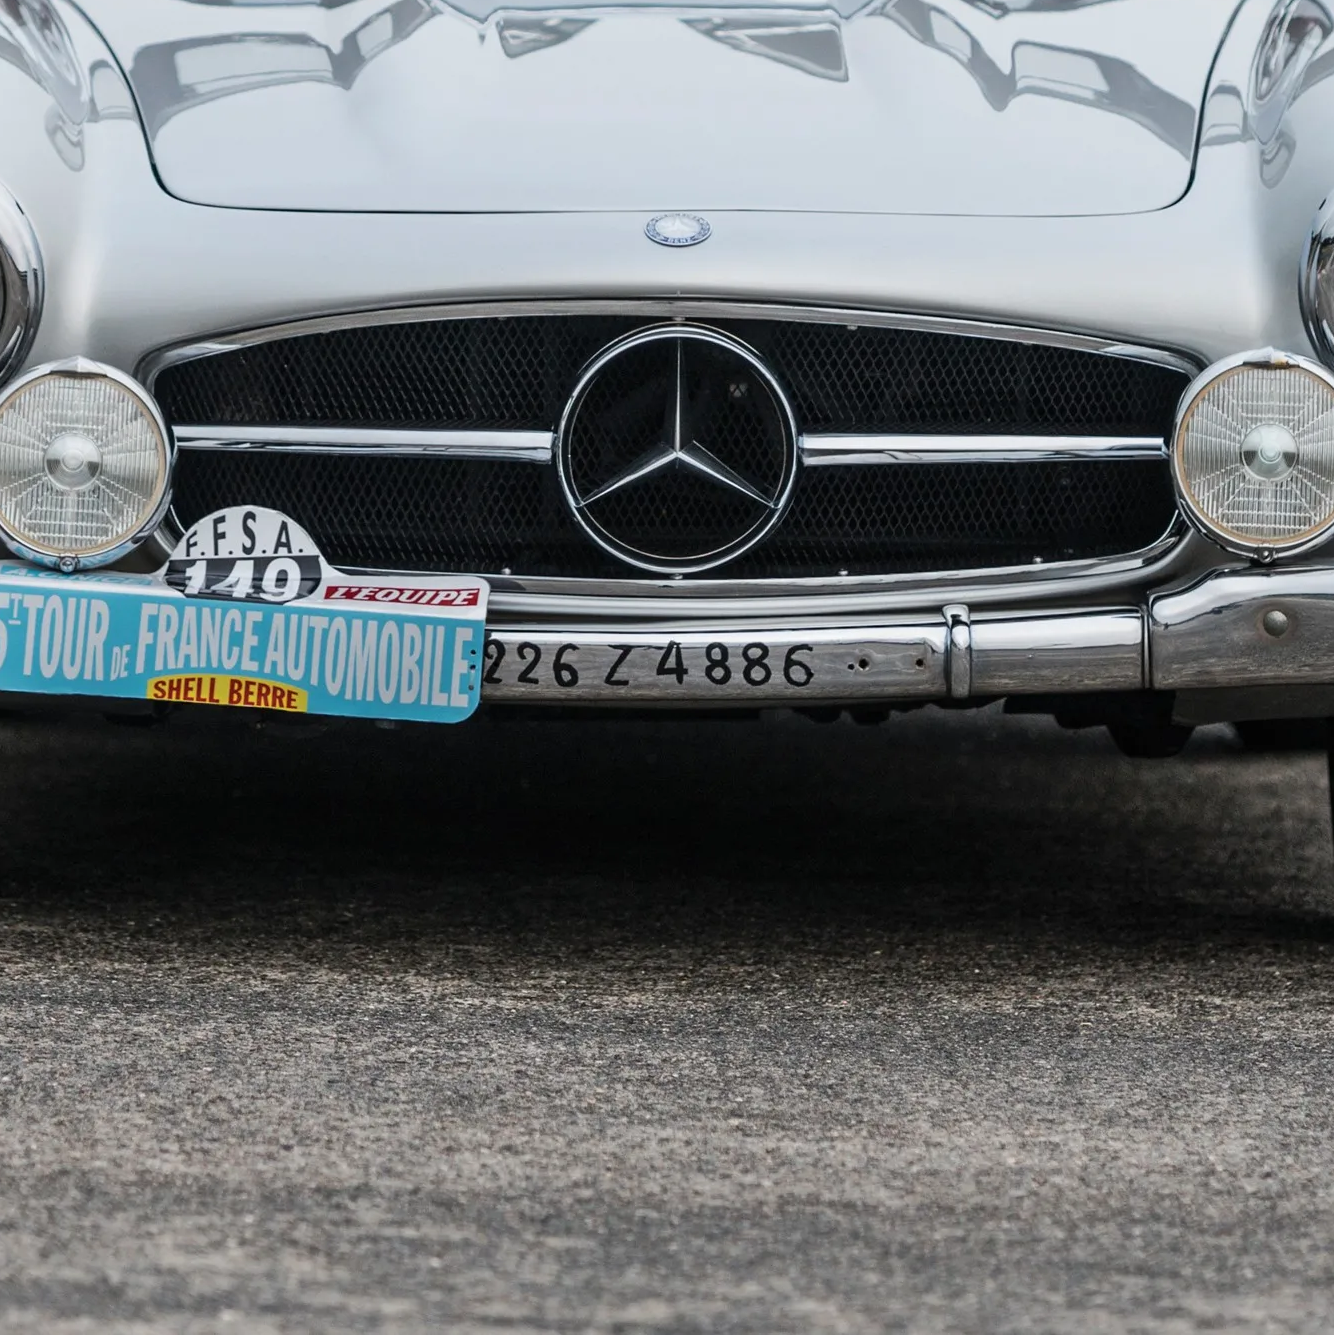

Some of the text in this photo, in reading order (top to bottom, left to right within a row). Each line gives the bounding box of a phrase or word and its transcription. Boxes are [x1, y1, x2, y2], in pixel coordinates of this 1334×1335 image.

[183, 557, 302, 603] 149
[22, 594, 110, 681] TOUR
[109, 644, 132, 682] DE
[134, 602, 264, 675] FRANCE
[263, 612, 474, 708] AUTOMOBILE
[482, 638, 815, 688] 226 Z 4886
[152, 676, 299, 710] SHELL BERRE
